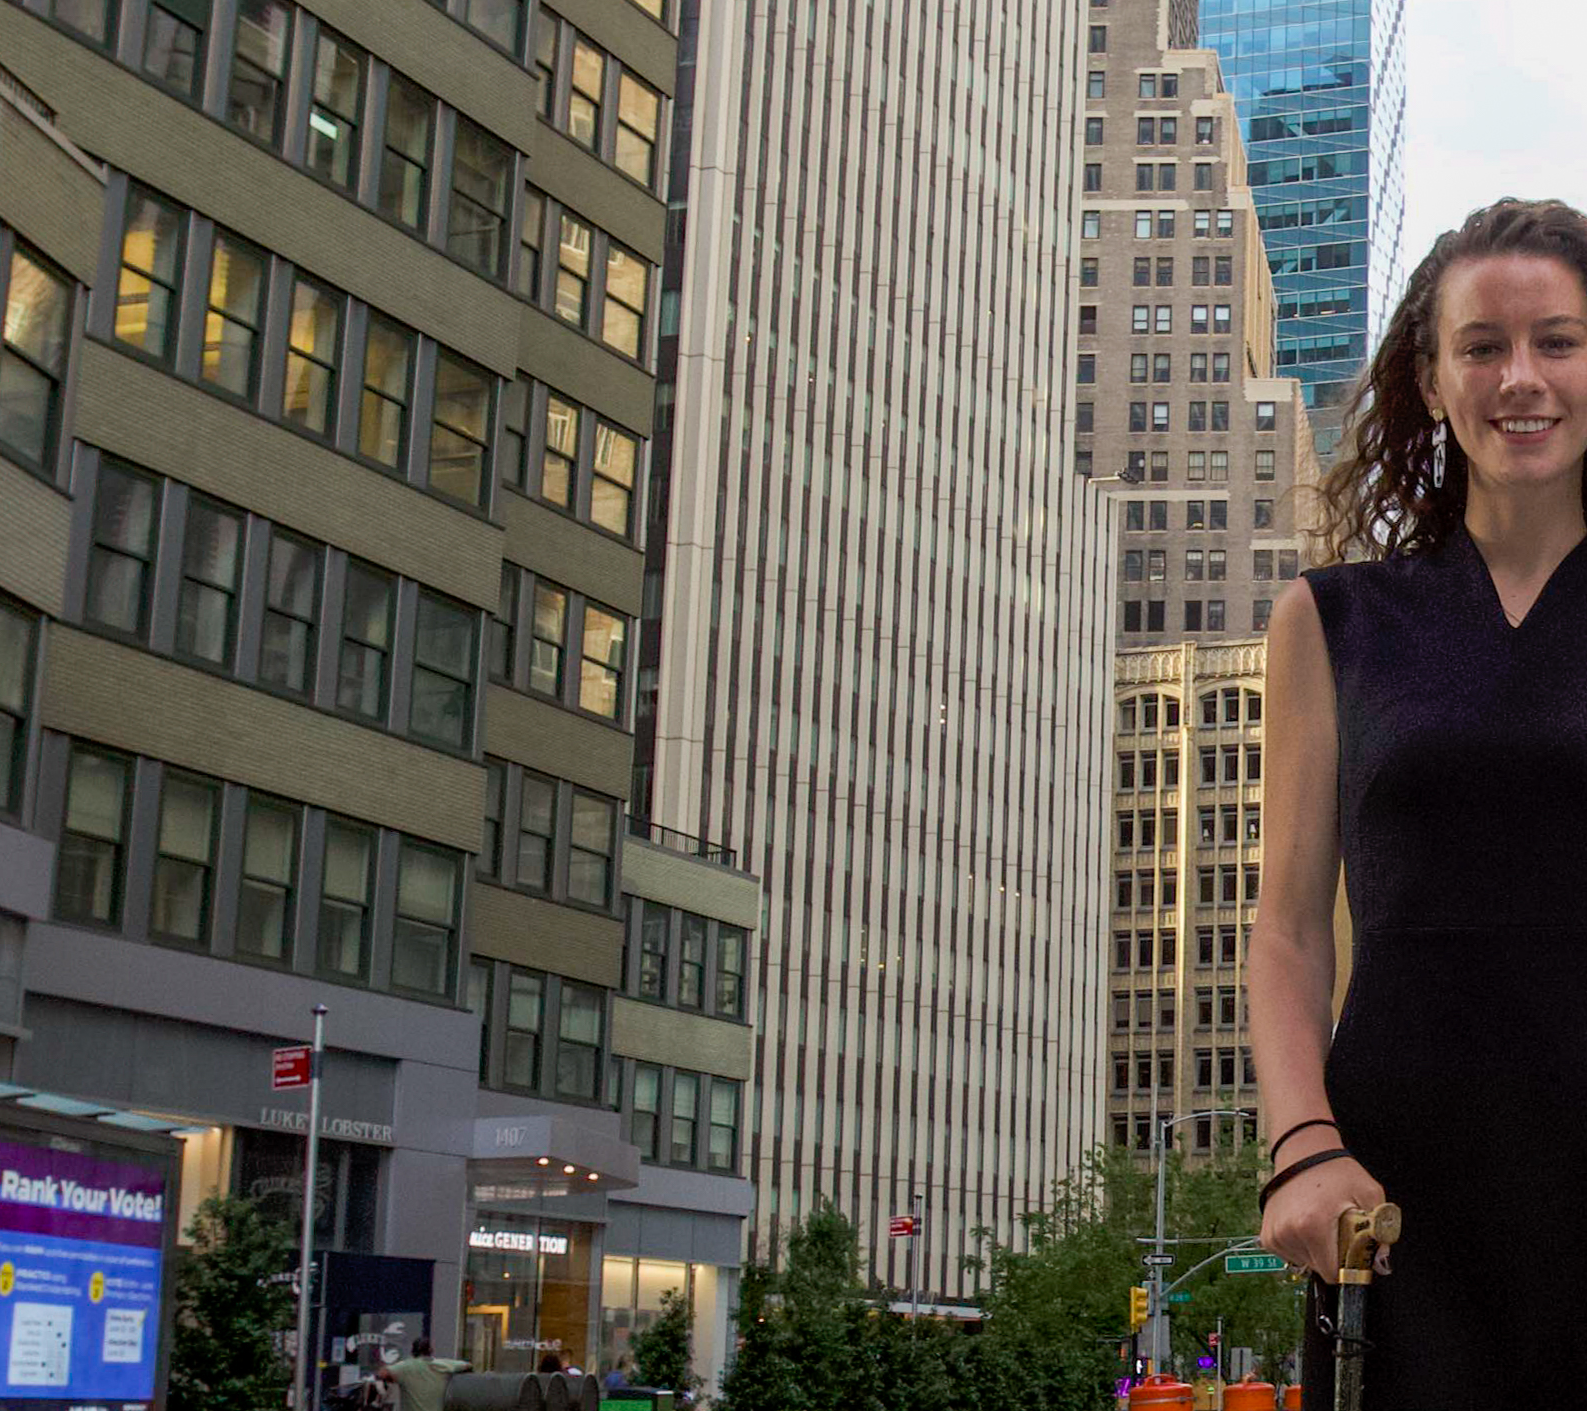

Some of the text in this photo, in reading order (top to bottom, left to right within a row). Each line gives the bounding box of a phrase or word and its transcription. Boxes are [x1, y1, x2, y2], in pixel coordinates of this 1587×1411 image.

[321, 1116, 393, 1141] LOBSTER
[0, 1169, 60, 1207] Rank
[60, 1179, 111, 1212] Your
[109, 1187, 162, 1221] Vote!
[494, 1232, 568, 1255] GENERTION
